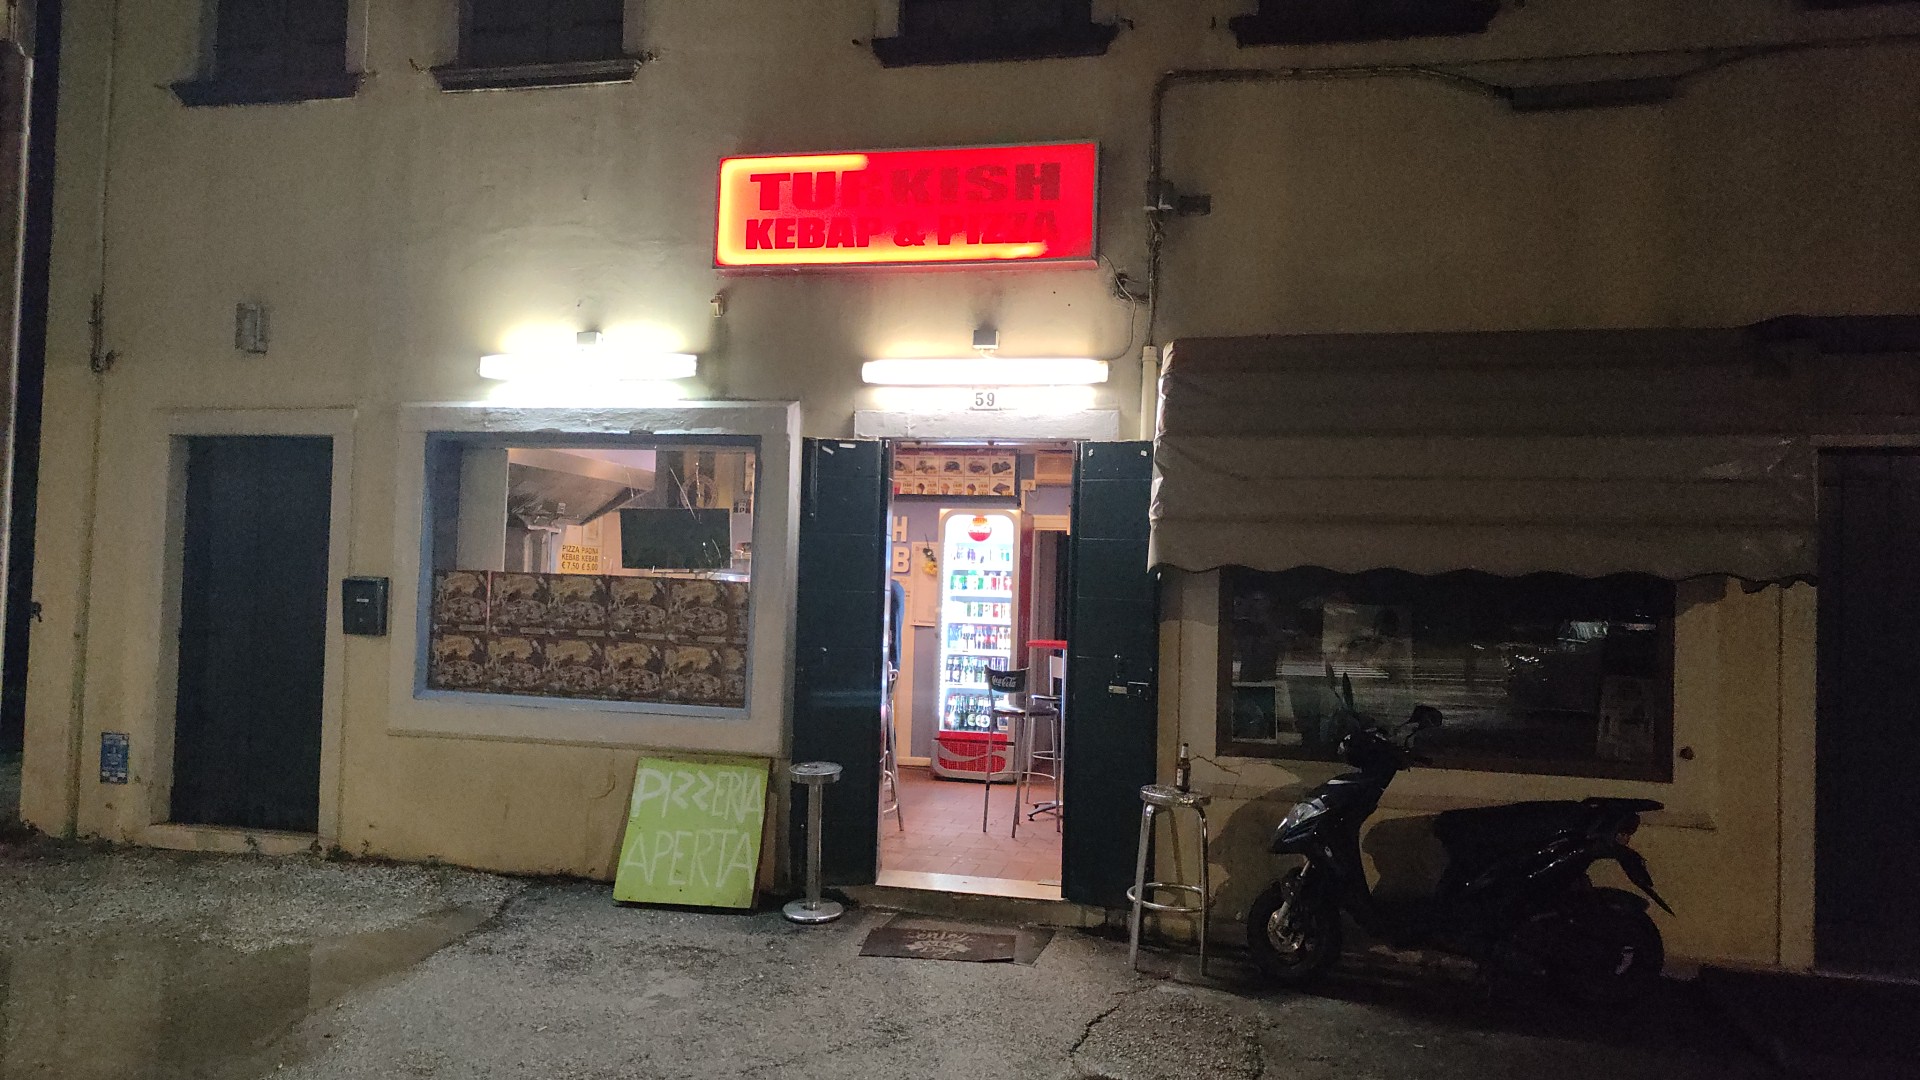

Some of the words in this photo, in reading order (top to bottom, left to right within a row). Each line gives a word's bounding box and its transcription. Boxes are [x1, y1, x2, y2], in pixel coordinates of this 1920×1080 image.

[750, 162, 1061, 211] TURKISH
[745, 216, 882, 249] KEBAP
[891, 220, 926, 246] &
[936, 209, 1061, 245] PIZZA
[975, 392, 995, 406] 59
[561, 553, 580, 561] KEBAB
[562, 545, 580, 553] PIZZA
[630, 768, 765, 824] PIZZERIA
[624, 829, 755, 891] APERTA
